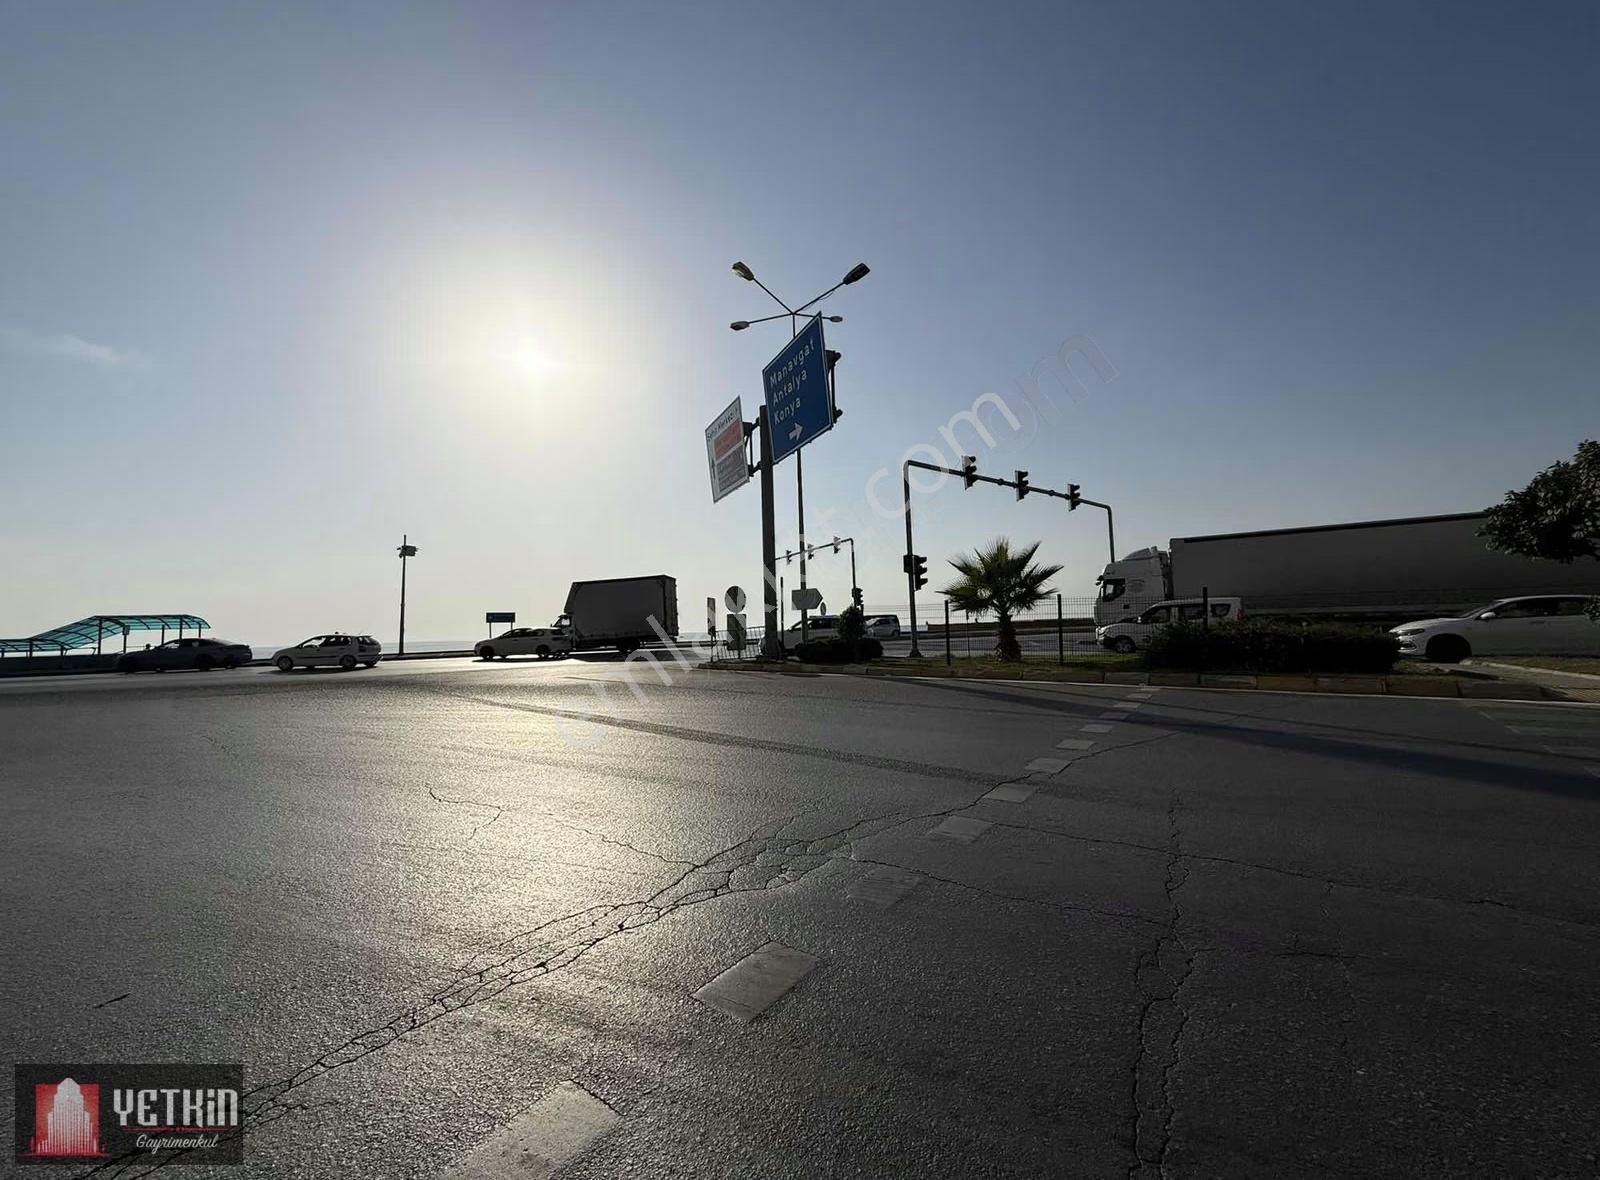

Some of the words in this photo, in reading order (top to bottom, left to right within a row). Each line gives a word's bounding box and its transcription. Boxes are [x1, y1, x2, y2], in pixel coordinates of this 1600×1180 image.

[770, 338, 815, 388] Manavgat
[773, 369, 808, 407] Antalya
[774, 397, 801, 425] Konya
